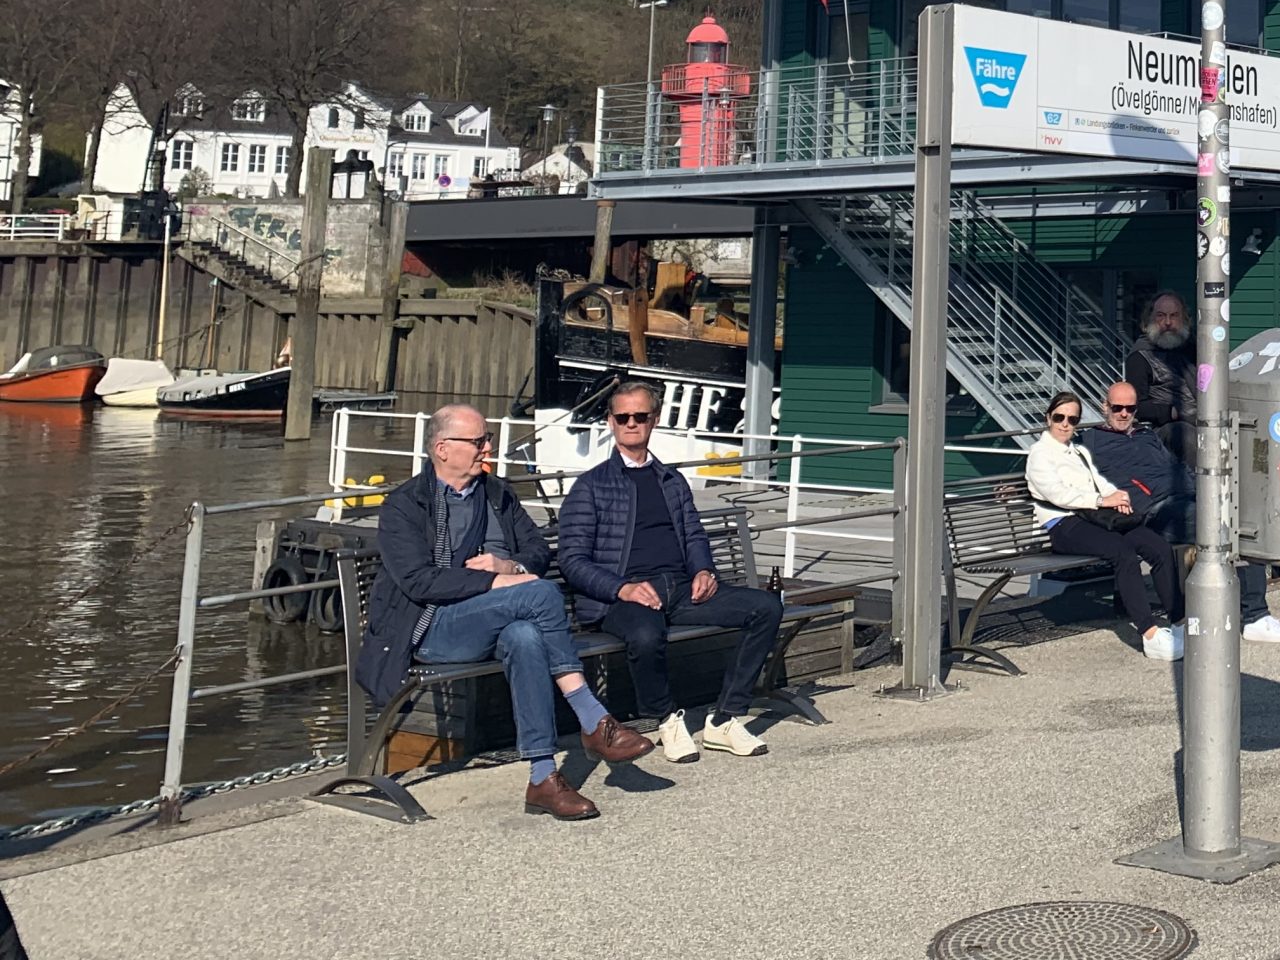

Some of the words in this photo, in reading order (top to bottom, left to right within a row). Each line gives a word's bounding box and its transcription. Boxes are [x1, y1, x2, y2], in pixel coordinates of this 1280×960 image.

[976, 57, 1016, 81] Fähre
[1128, 40, 1258, 96] Neumlen
[1047, 112, 1059, 124] 62
[1111, 85, 1277, 129] (Övelgönne/Mmshafen)
[1044, 135, 1062, 146] hvv
